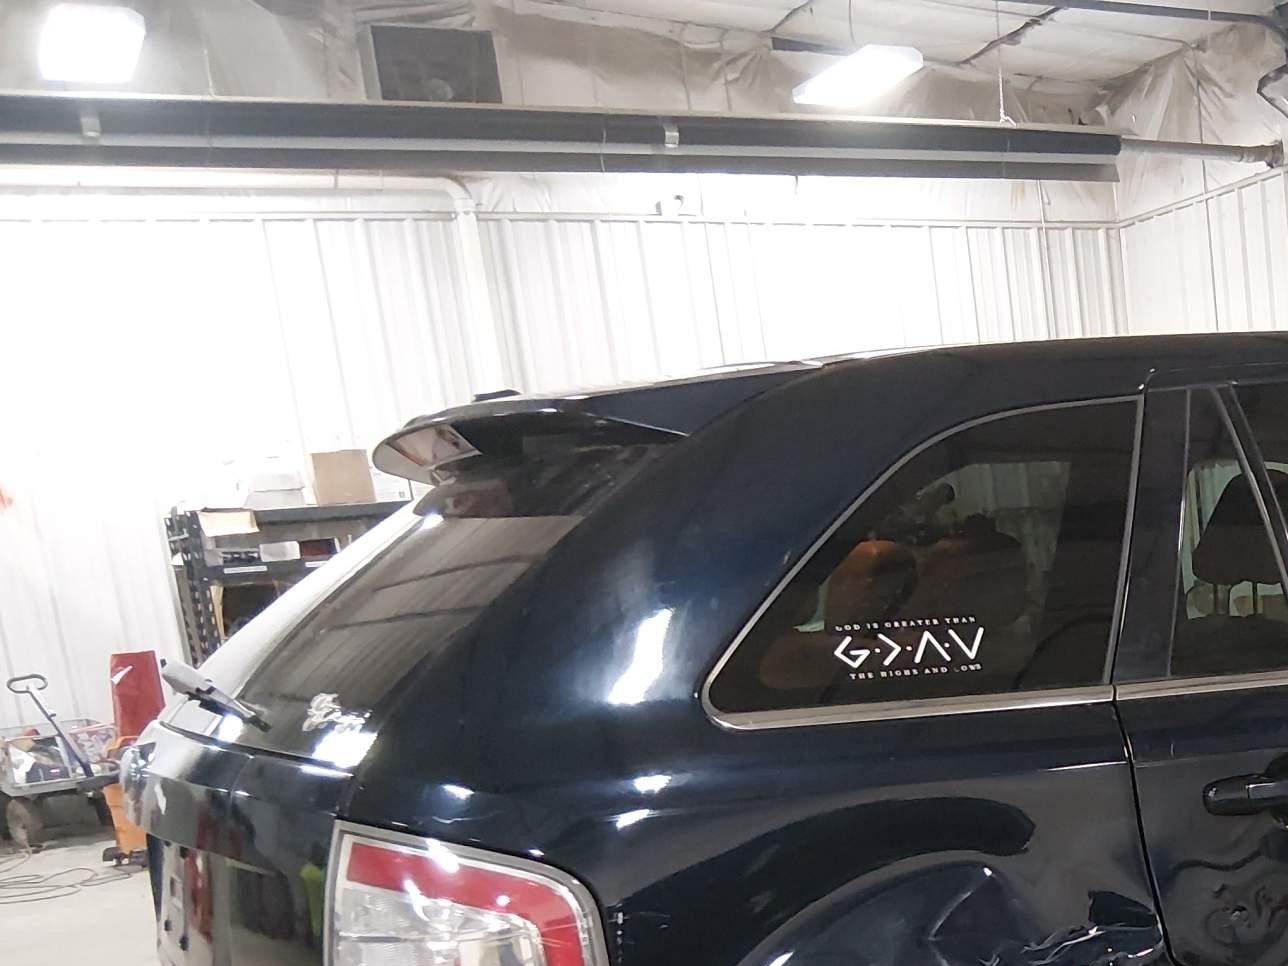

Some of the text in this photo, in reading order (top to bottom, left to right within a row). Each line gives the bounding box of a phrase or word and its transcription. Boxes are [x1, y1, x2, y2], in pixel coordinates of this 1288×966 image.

[834, 616, 976, 632] GOD IS GREATER THAN
[849, 672, 875, 680] THE
[924, 666, 949, 674] AND
